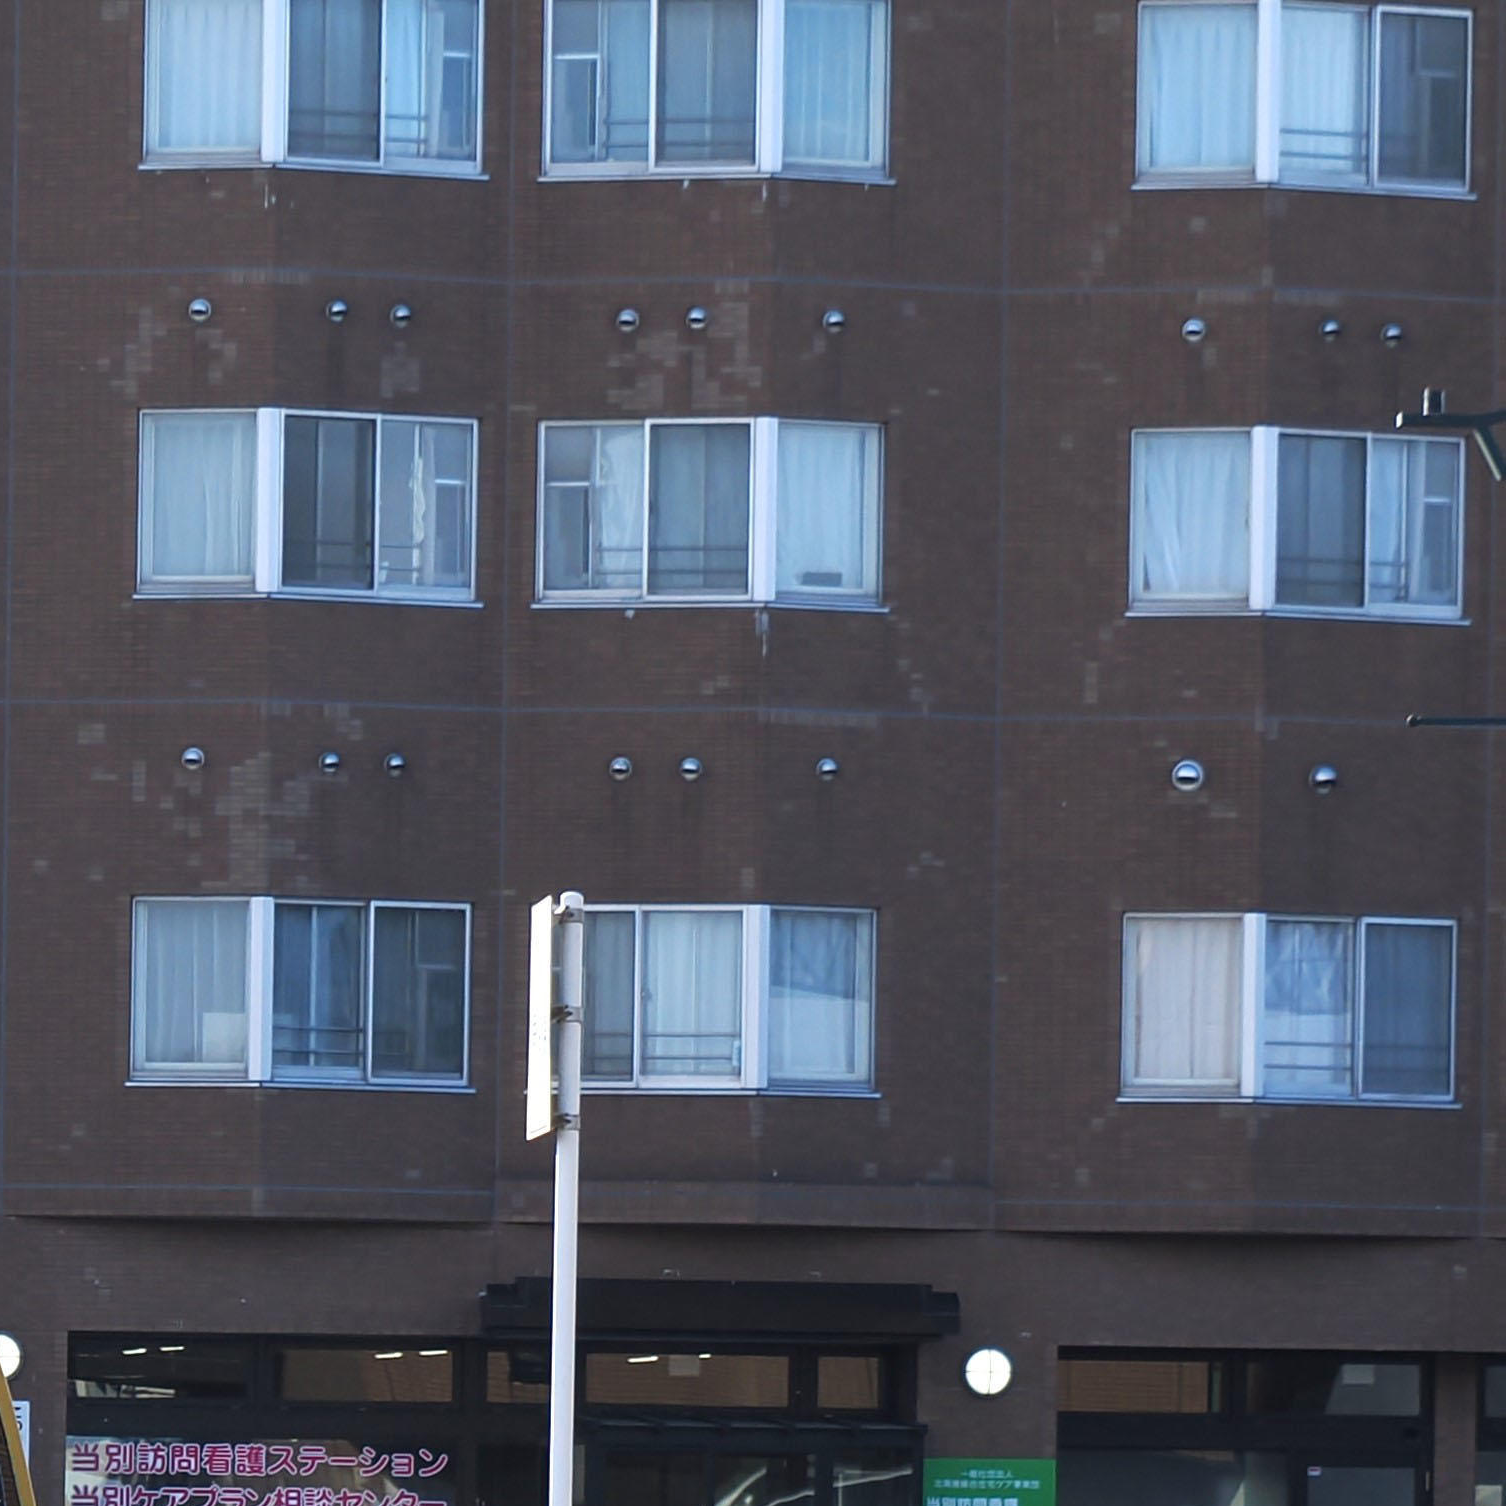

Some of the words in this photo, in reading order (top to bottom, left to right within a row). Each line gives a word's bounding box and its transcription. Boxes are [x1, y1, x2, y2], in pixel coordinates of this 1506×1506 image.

[71, 1442, 449, 1477] 当別訪問看護ステーション
